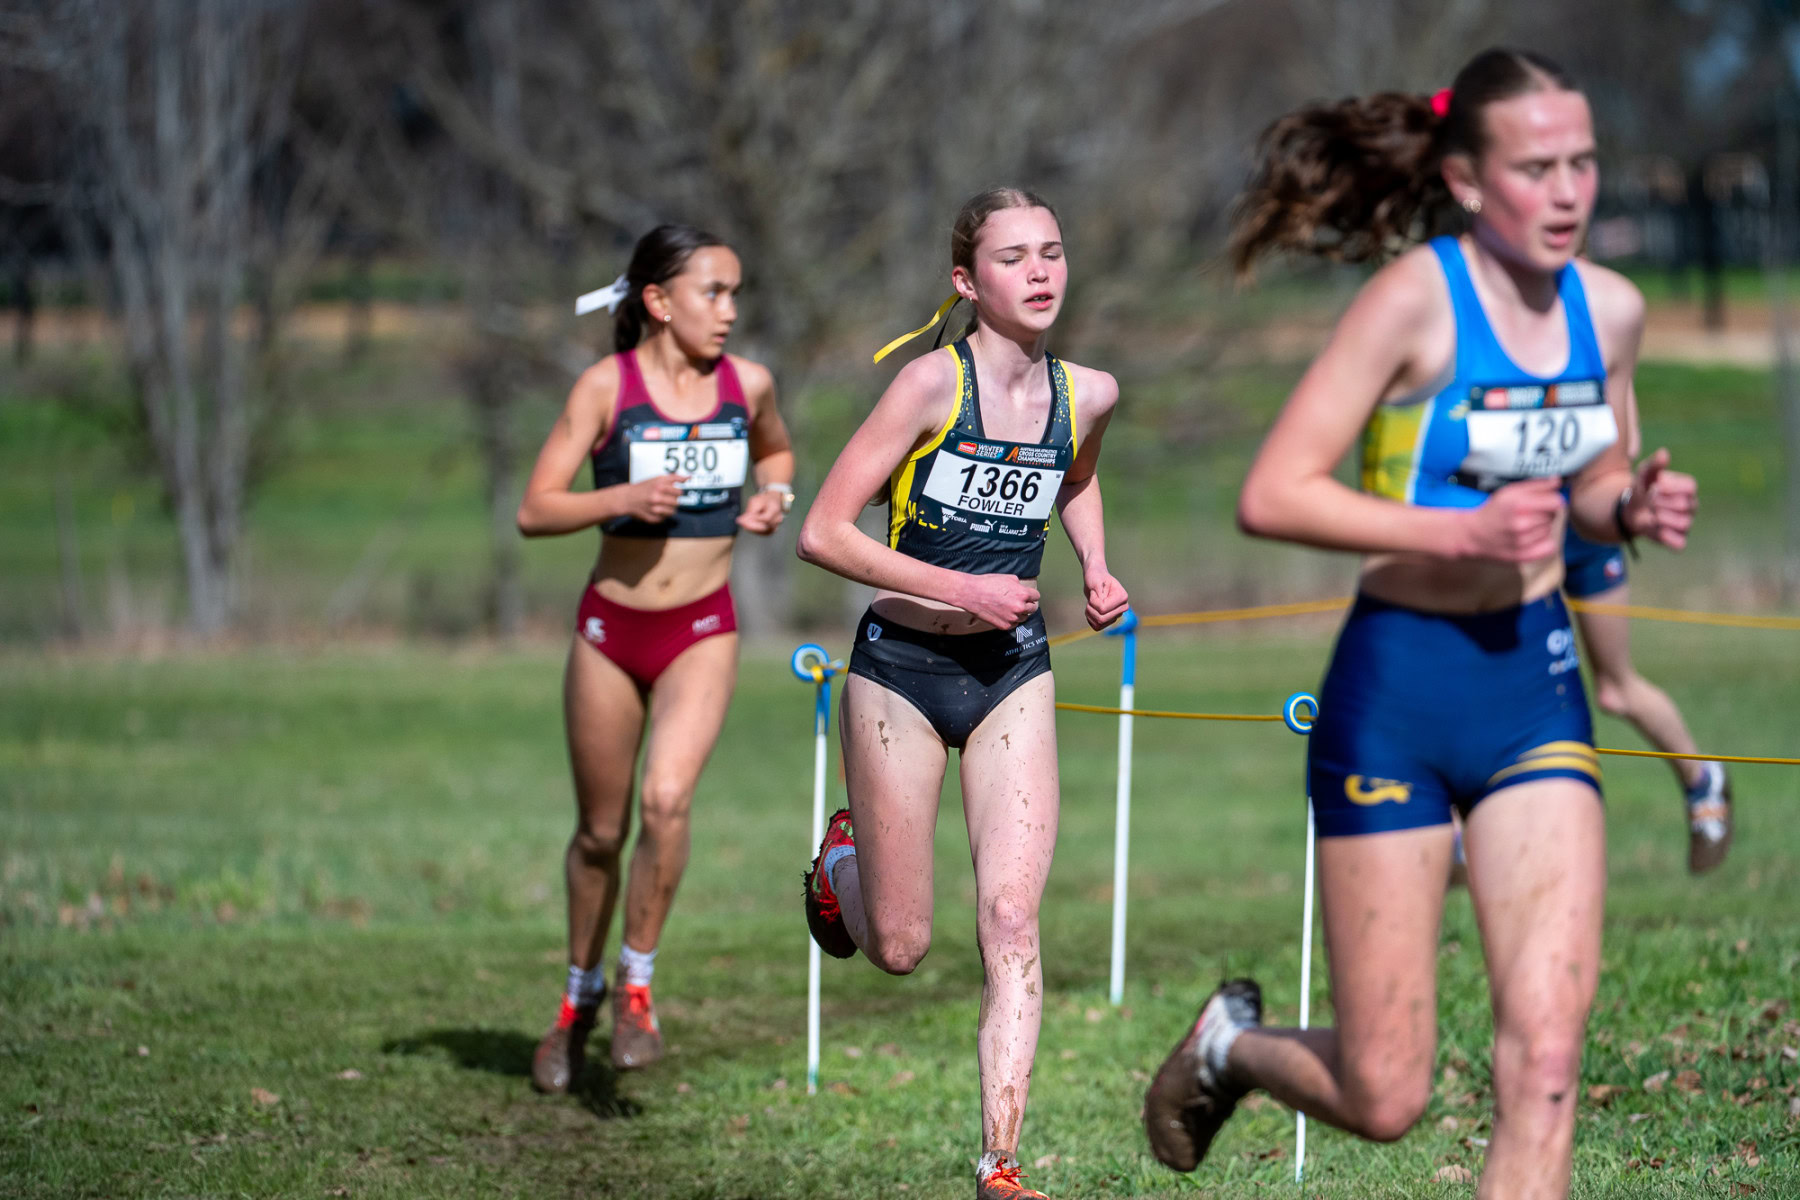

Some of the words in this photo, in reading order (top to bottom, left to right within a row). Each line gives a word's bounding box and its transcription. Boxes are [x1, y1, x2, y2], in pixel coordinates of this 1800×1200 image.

[1515, 413, 1580, 455] 120
[976, 449, 997, 459] SERIES
[978, 443, 1004, 454] WINTER
[665, 446, 718, 474] 580
[960, 463, 1042, 503] 1366
[957, 494, 1025, 516] FOWLER
[943, 513, 967, 523] VICTORIA
[970, 523, 990, 533] PUMA
